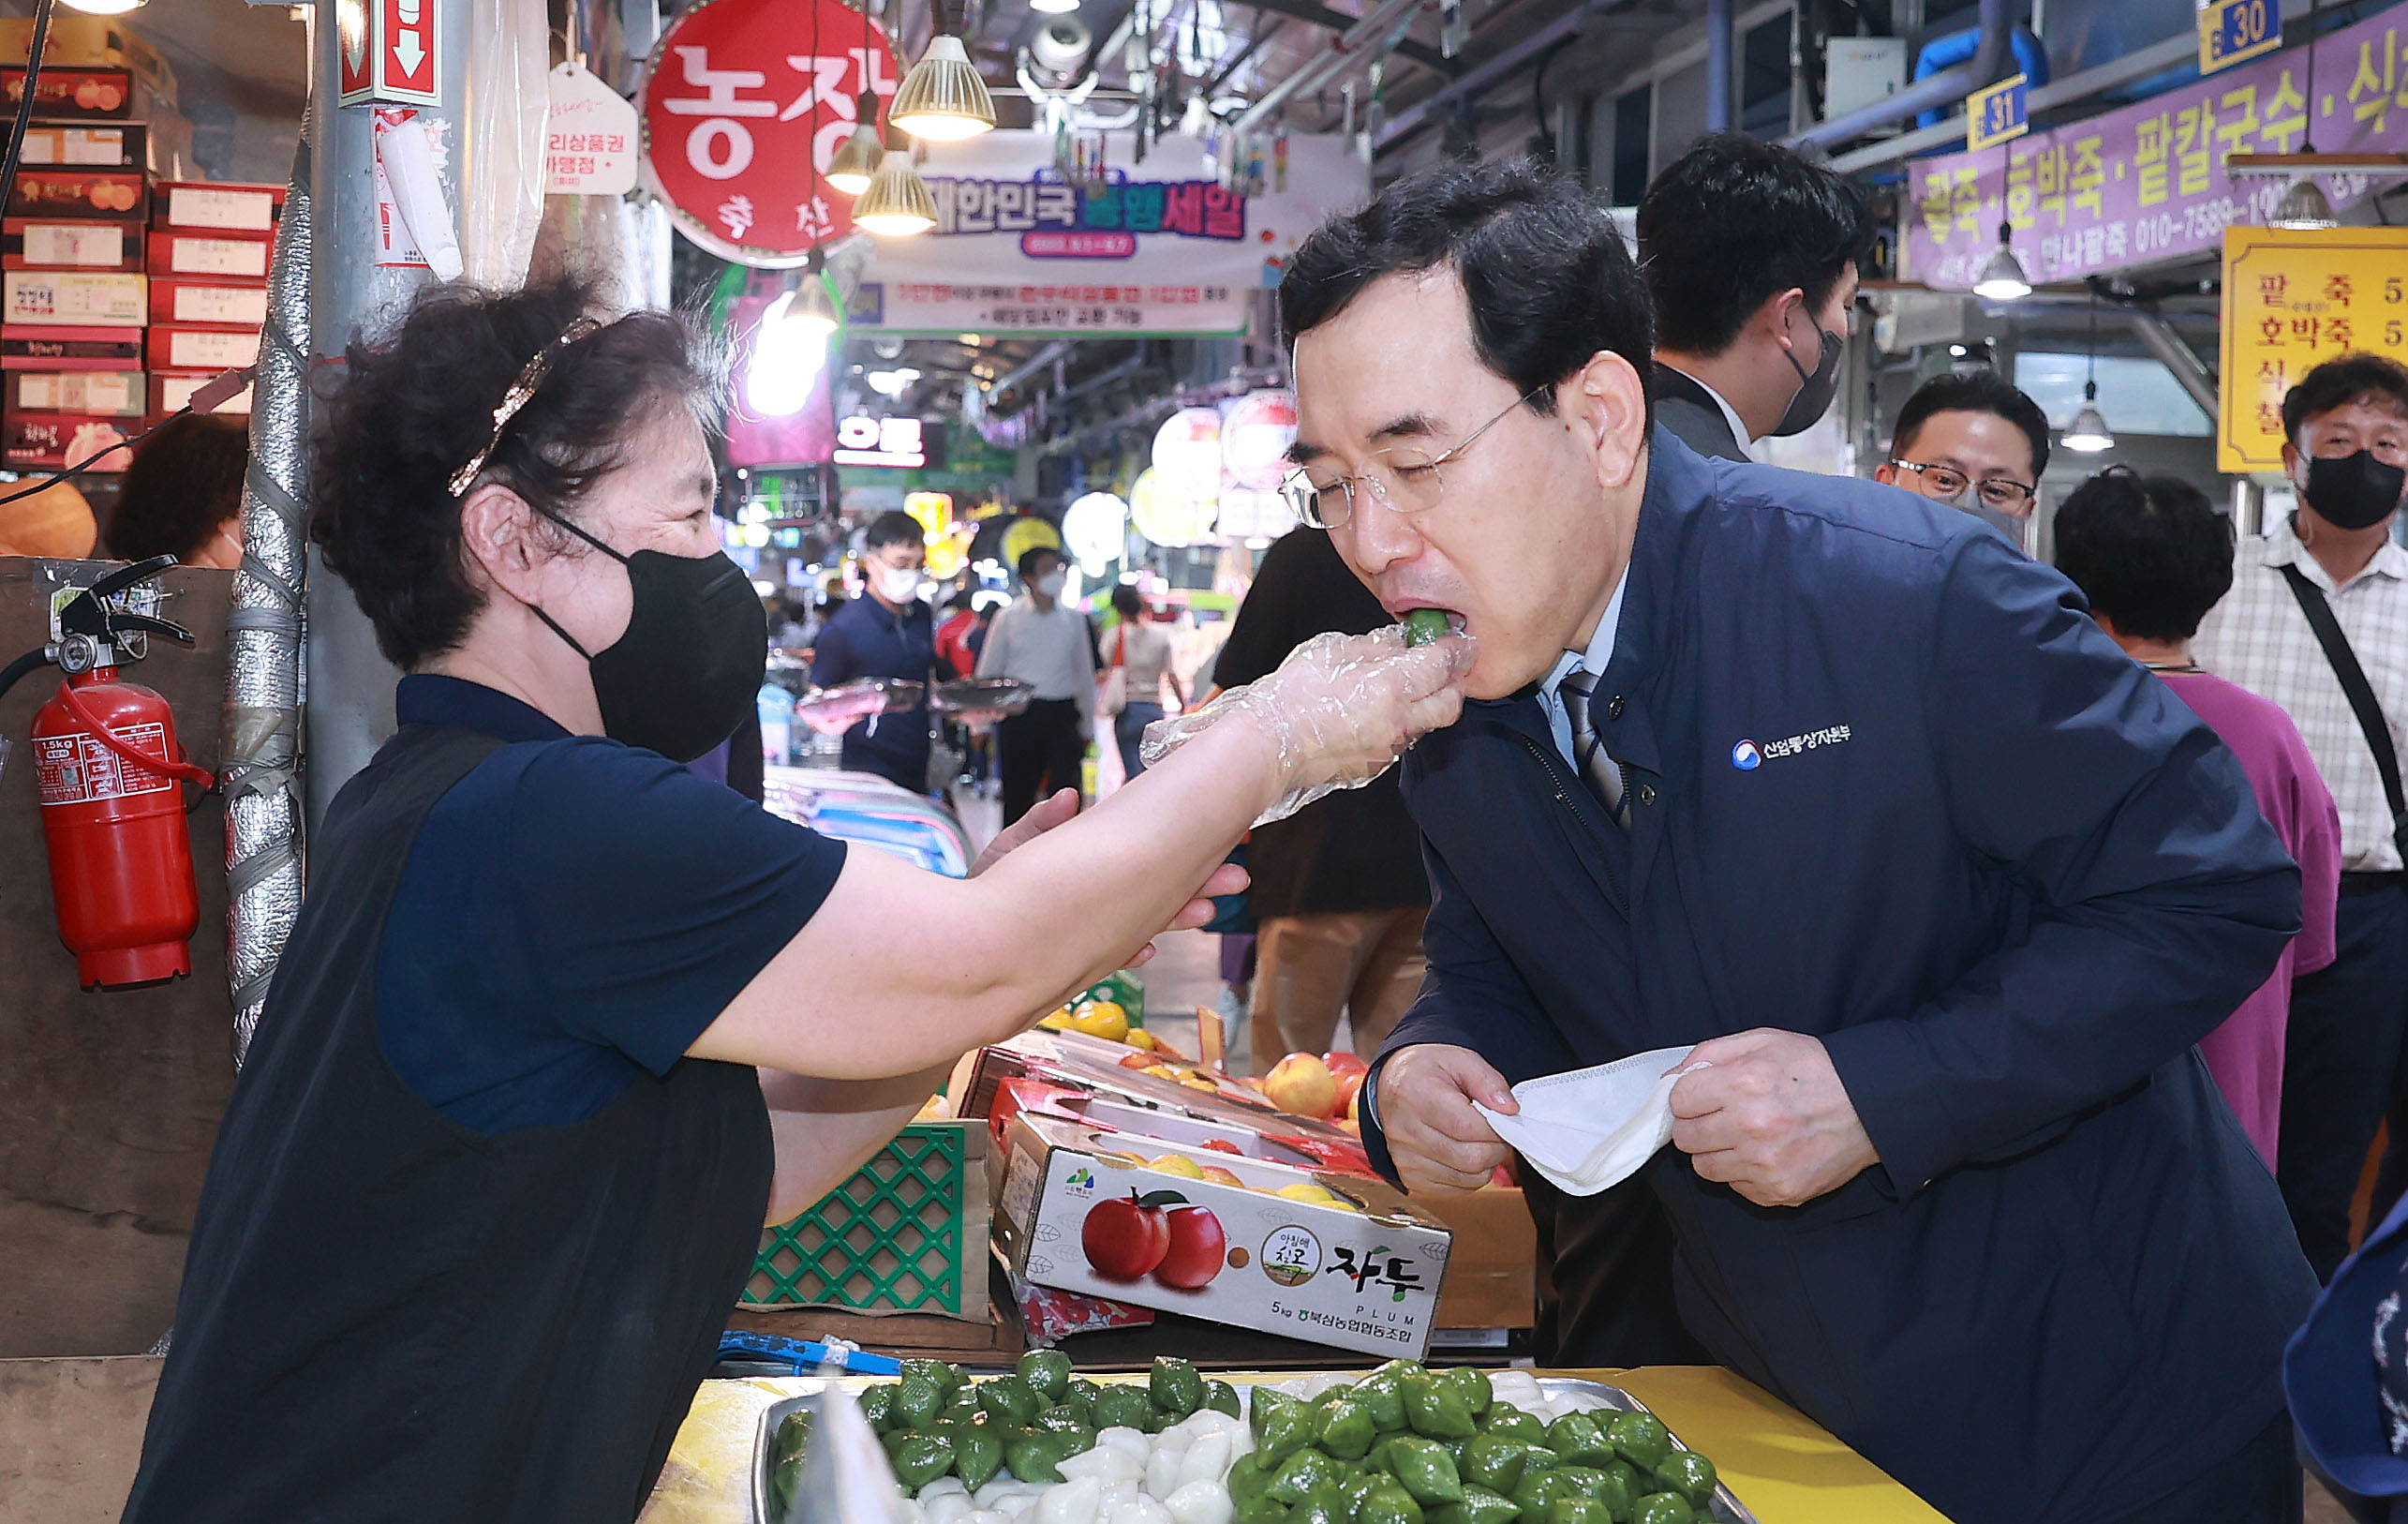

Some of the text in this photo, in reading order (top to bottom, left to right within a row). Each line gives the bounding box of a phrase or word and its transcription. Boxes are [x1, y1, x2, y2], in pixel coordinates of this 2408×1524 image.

[2233, 1, 2267, 48] 30
[662, 45, 898, 180] 농장
[1991, 92, 2014, 132] 31
[2007, 136, 2106, 231] 호박죽
[2134, 70, 2307, 206] 팥칼국수
[2347, 28, 2408, 134] 식
[2257, 317, 2353, 350] 호박죽
[1763, 724, 1851, 759] 산업통상자원부
[1326, 1246, 1425, 1303] 자두
[1310, 1311, 1413, 1343] 북삼농업협동조합
[1357, 1305, 1415, 1326] PLUM
